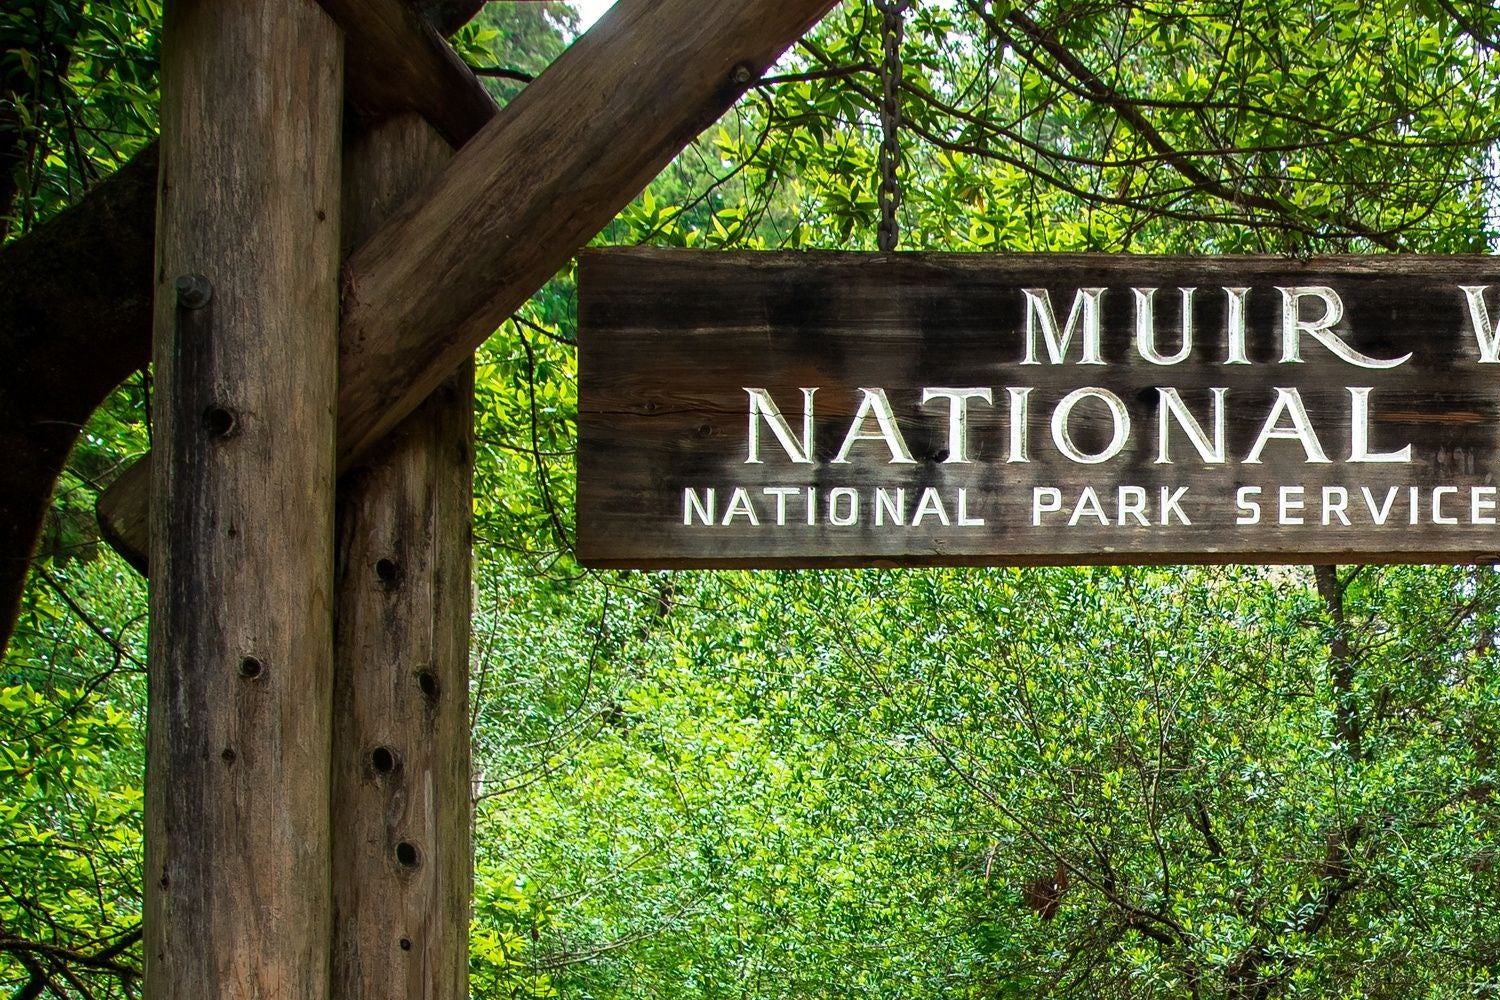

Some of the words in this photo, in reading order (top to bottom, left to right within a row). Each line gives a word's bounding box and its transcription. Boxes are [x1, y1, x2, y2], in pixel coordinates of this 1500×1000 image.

[1019, 286, 1412, 368] MUIR
[742, 386, 1412, 464] NATIONAL
[683, 486, 985, 527] NATIONAL
[1032, 485, 1192, 527] PARK
[1234, 485, 1497, 527] SERVICE
